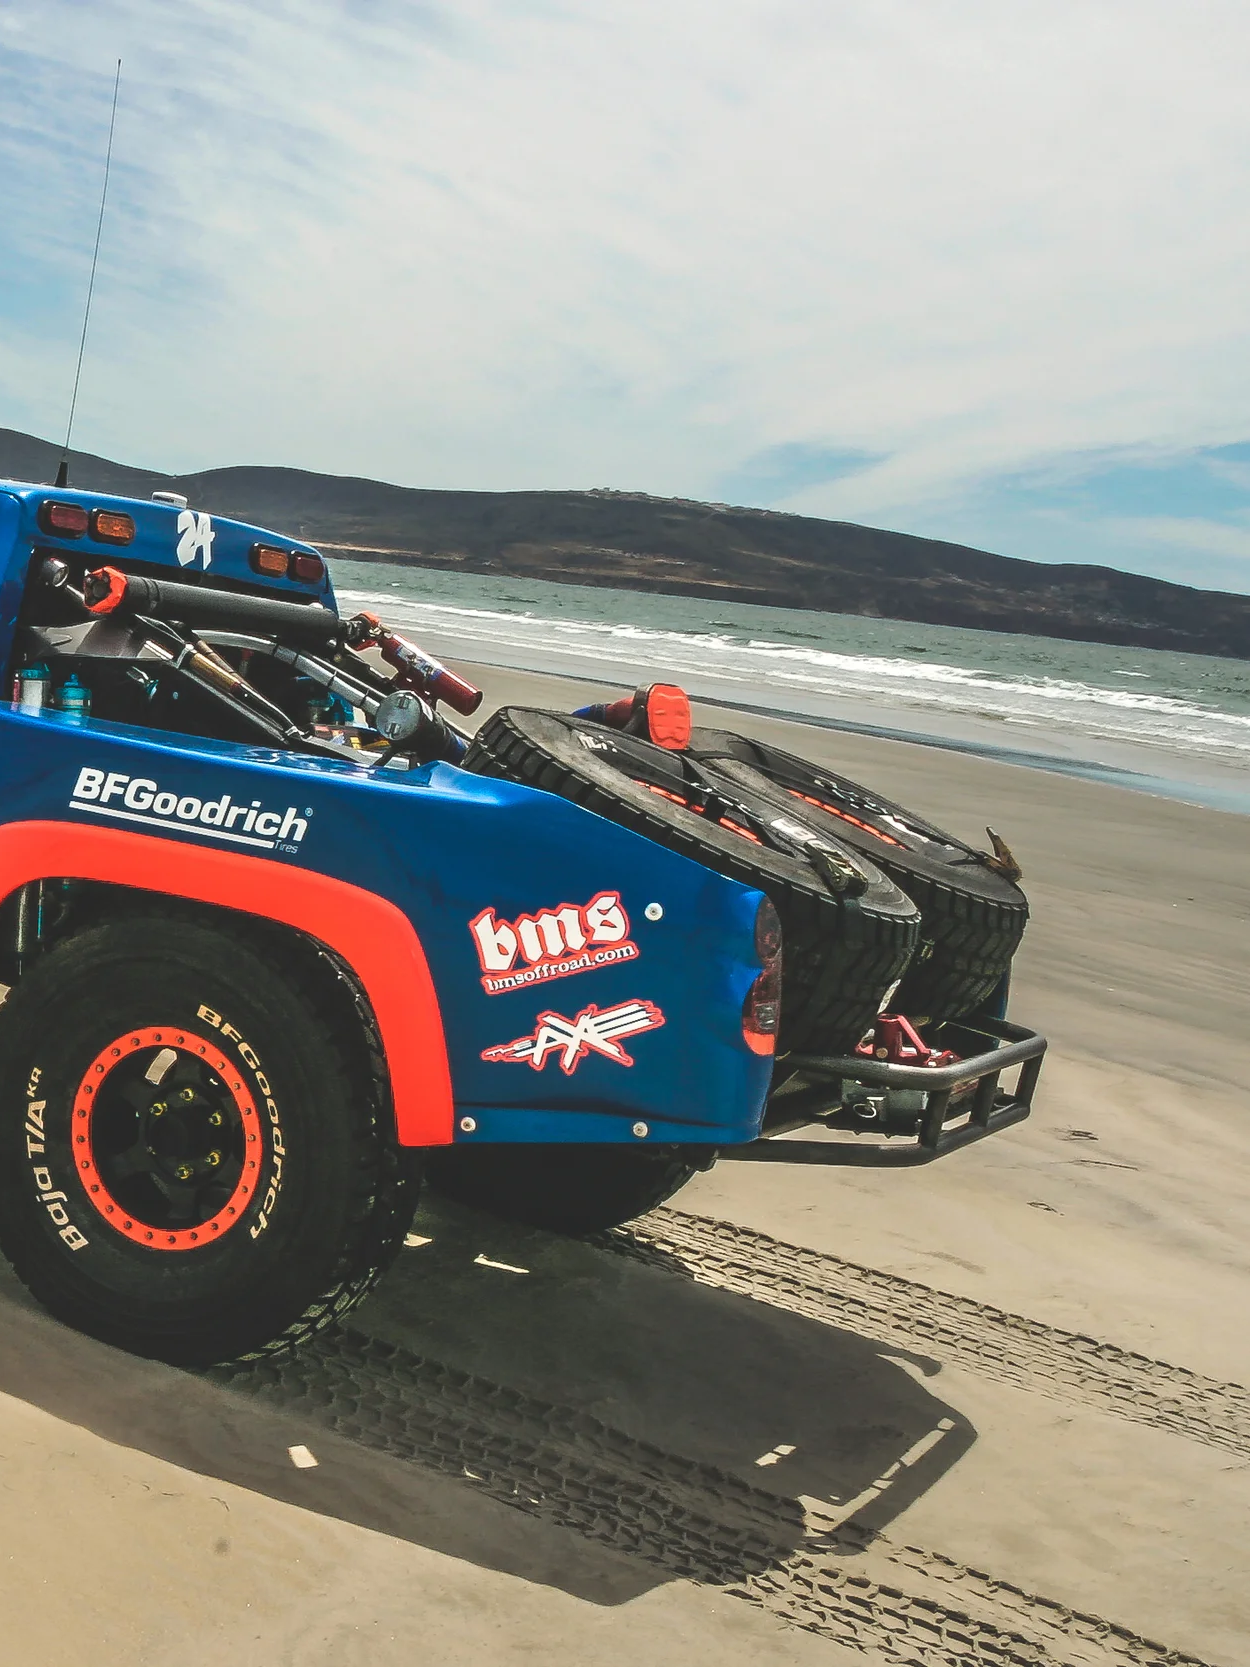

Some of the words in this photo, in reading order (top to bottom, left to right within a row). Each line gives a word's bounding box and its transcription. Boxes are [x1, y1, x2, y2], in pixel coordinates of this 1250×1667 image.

[176, 509, 216, 571] 24
[72, 766, 309, 842] BFGoodrich
[274, 838, 299, 854] Tires
[474, 895, 627, 971] bms
[485, 944, 636, 992] bmsoffroad.com
[25, 1100, 47, 1159] T/A
[196, 1004, 286, 1239] BFGoodrich
[33, 1166, 89, 1251] Baja
